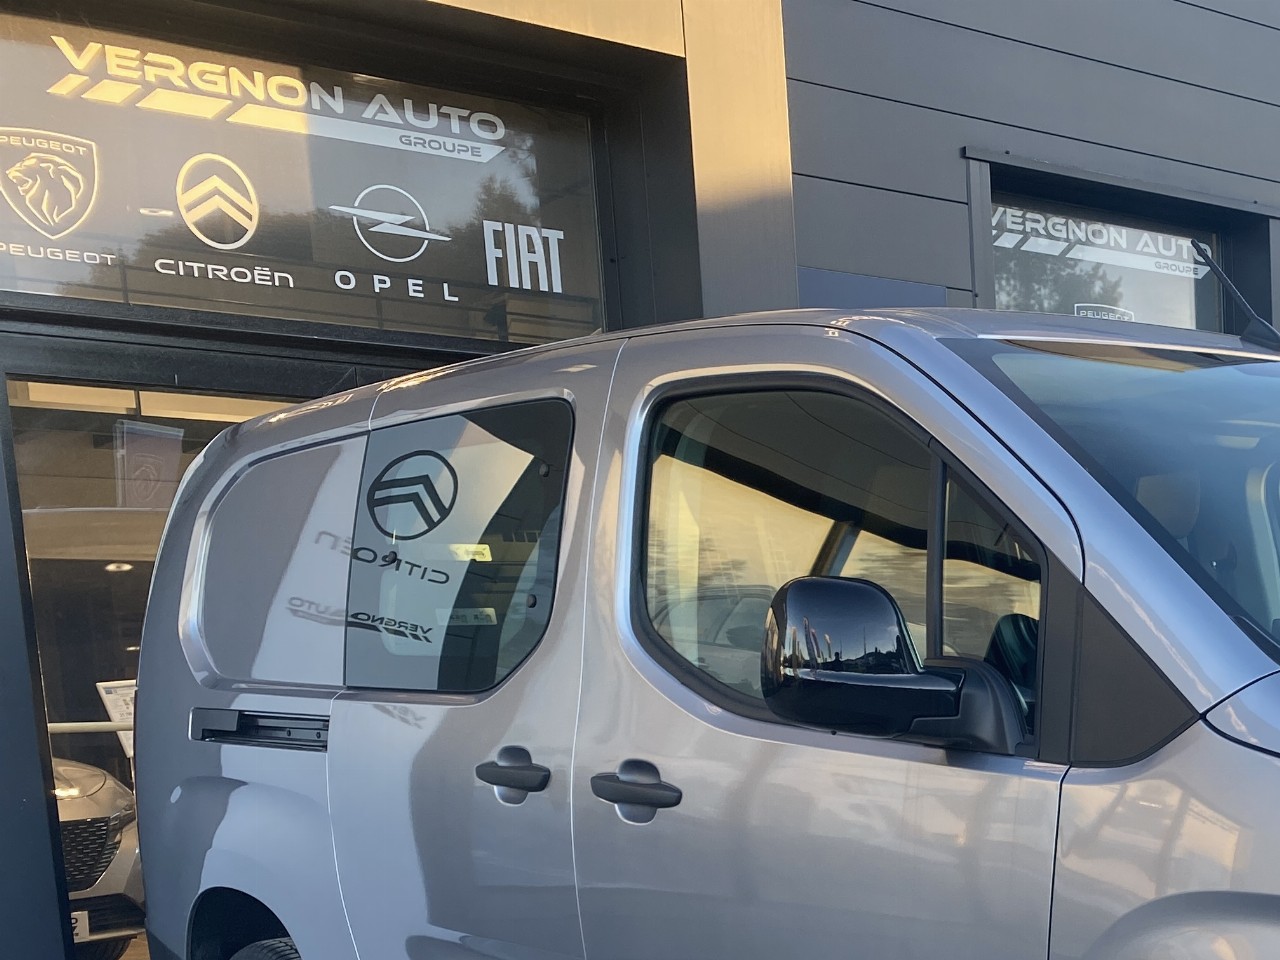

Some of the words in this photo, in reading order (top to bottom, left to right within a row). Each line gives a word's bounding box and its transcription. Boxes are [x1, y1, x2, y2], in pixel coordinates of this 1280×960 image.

[51, 35, 345, 114] VERGNON
[361, 93, 505, 140] AUTO
[399, 134, 482, 157] GROUPE
[483, 219, 564, 294] FIAT
[1135, 233, 1213, 264] AUTO
[1154, 260, 1199, 276] GROUPE
[334, 270, 459, 302] OPEL
